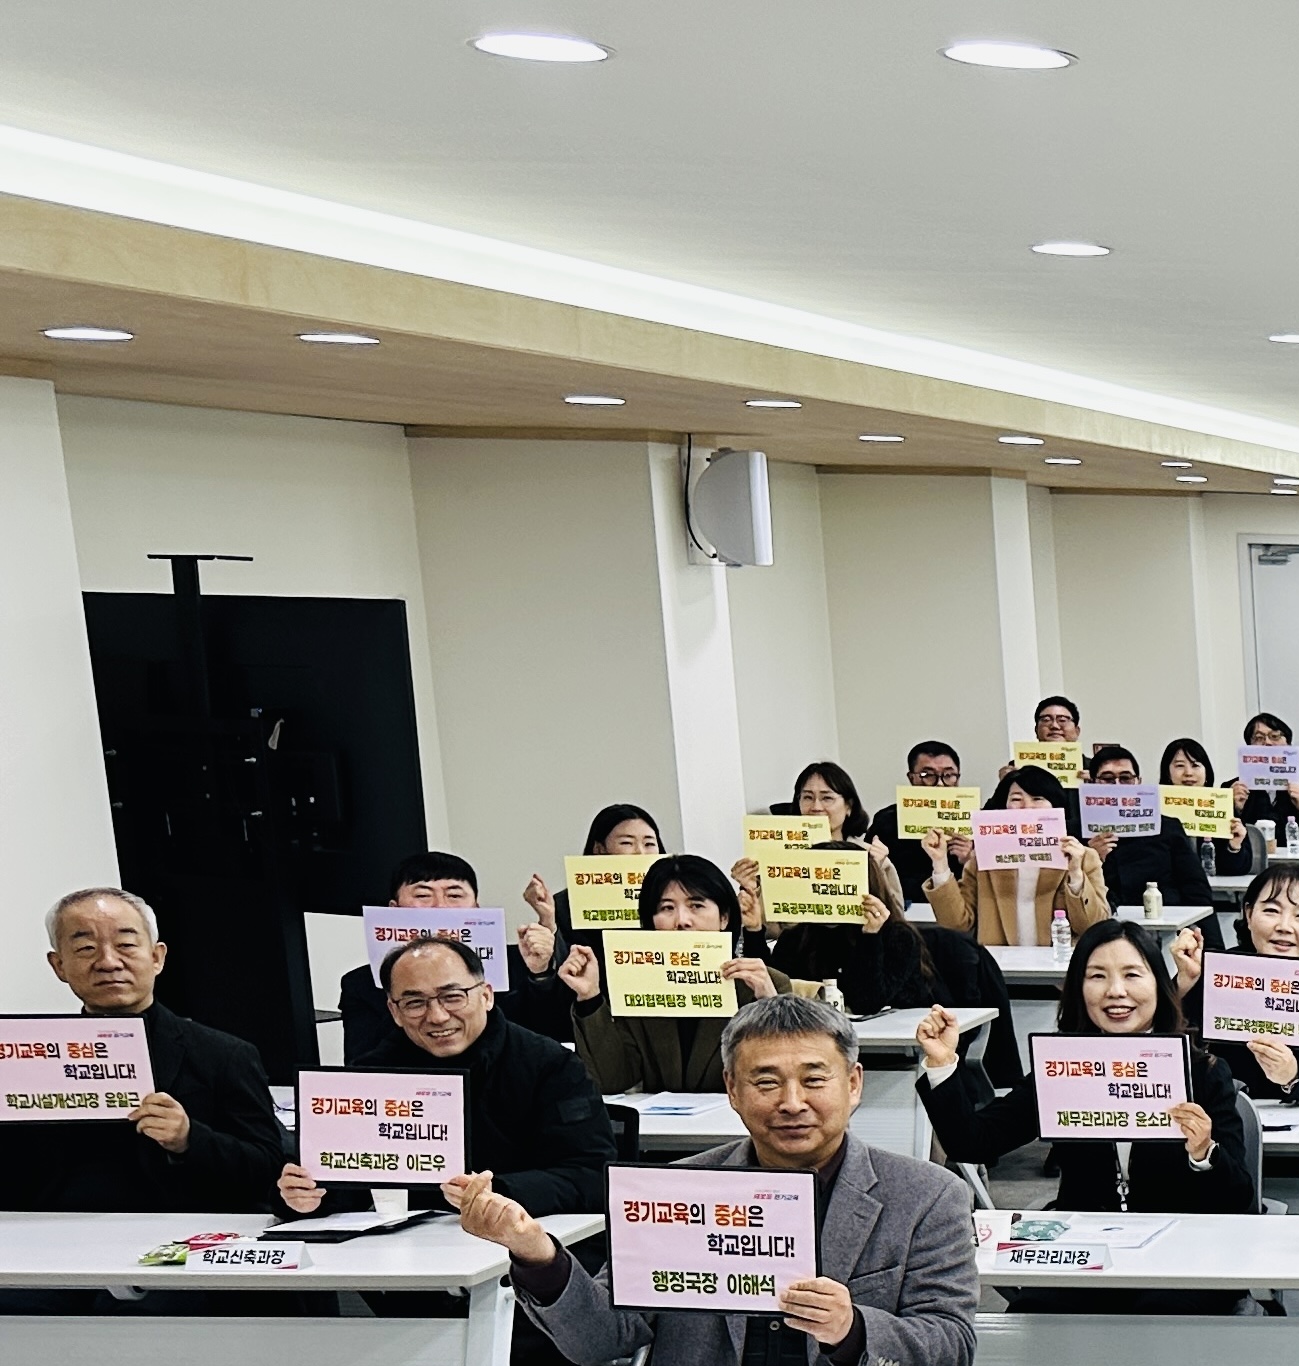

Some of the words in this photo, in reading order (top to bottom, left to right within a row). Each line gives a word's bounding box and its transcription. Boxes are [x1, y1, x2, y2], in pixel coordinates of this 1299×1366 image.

[575, 873, 622, 885] 경기교육의
[767, 866, 810, 878] 경기교육의
[815, 868, 840, 879] 중심은
[614, 951, 664, 965] 경기교육의
[670, 952, 700, 966] 중심은
[667, 971, 721, 984] 학교입니다!
[1214, 974, 1265, 991] 경기교육의
[67, 1043, 108, 1058] 중심은
[64, 1064, 136, 1080] 학교입니다!
[1046, 1061, 1106, 1077] 경기교육의
[1112, 1062, 1148, 1077] 중심은
[1108, 1083, 1171, 1099] 학교입니다!
[6, 1094, 98, 1109] 학교시설개선과장
[312, 1098, 377, 1116] 경기교육의
[385, 1100, 423, 1117] 중심은
[1057, 1111, 1129, 1127] 재무관리과장
[1136, 1112, 1171, 1127] 윤소라
[378, 1123, 448, 1141] 학교입니다!
[320, 1152, 399, 1170] 학교신축과장
[407, 1155, 445, 1171] 이근우
[624, 1201, 705, 1225] 경기교육의
[715, 1205, 763, 1227] 중심은
[707, 1234, 795, 1257] 학교입니다!
[202, 1250, 284, 1264] 학교신축과장
[1010, 1249, 1091, 1266] 재무관리과장
[652, 1271, 718, 1294] 행정국장
[727, 1274, 776, 1296] 이해석
